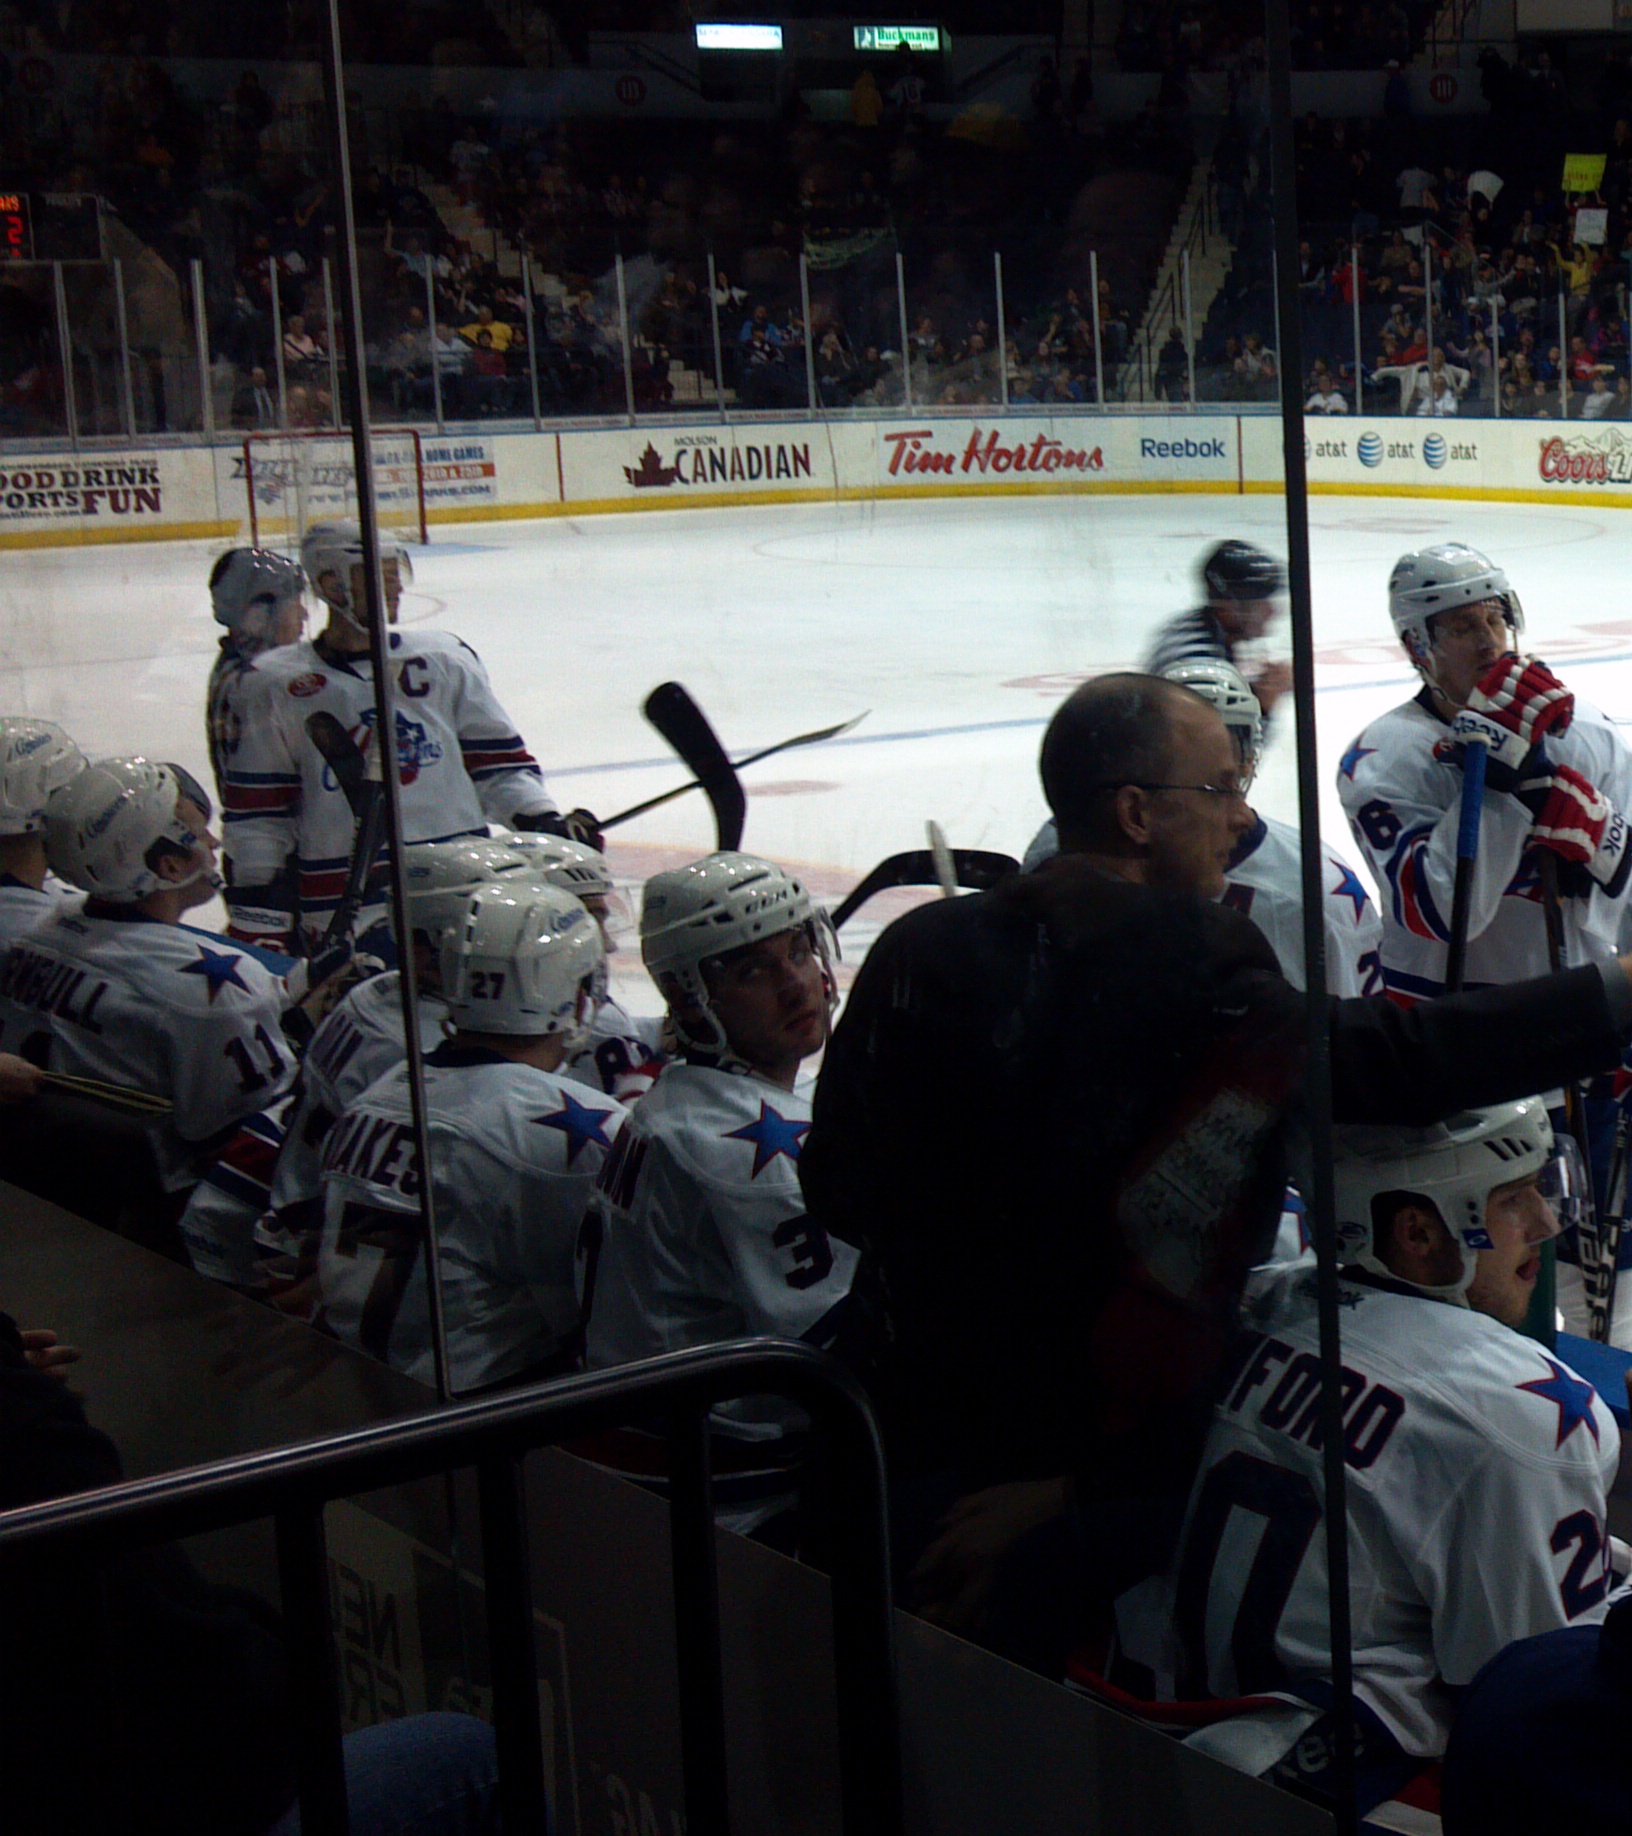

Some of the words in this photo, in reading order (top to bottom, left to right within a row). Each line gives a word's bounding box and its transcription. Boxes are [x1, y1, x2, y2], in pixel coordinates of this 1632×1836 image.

[426, 448, 452, 462] HOME
[453, 446, 484, 460] GAMES
[674, 435, 717, 447] MOLSON
[885, 430, 955, 476] Tim
[961, 426, 1104, 474] Hortons
[1141, 437, 1226, 459] Reebok
[1316, 441, 1347, 458] at&t
[1387, 442, 1414, 460] at&t
[1450, 443, 1478, 462] at&t
[675, 443, 812, 485] CANADIAN
[1540, 436, 1609, 482] Coors
[0, 471, 55, 490] OD
[60, 467, 161, 488] DRINK
[0, 490, 80, 509] ORTS
[80, 487, 162, 515] FUN
[400, 656, 431, 698] C
[470, 970, 505, 1000] 27
[224, 1024, 286, 1094] 11
[1231, 1338, 1405, 1472] FORD
